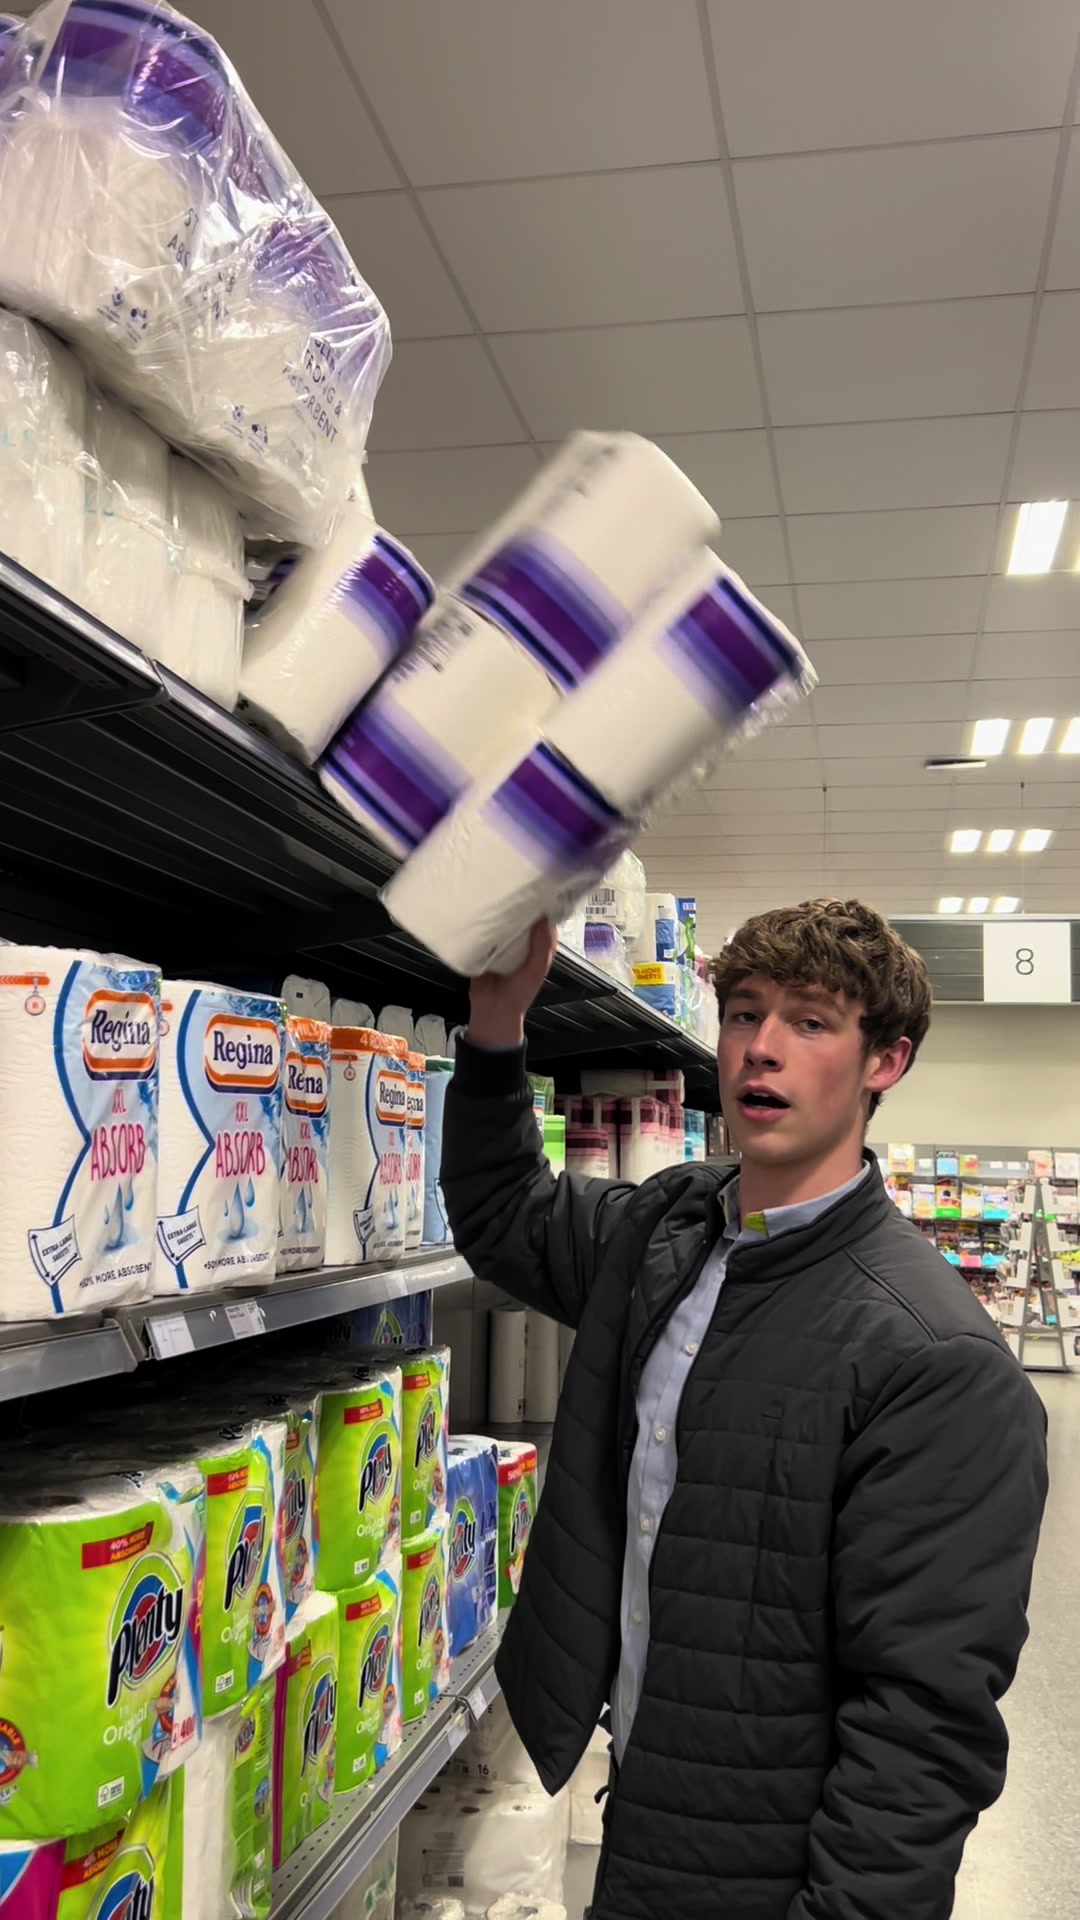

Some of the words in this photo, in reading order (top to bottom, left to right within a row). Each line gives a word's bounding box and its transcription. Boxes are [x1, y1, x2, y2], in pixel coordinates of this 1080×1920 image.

[1016, 948, 1034, 975] 8
[91, 1009, 151, 1052] Regina
[213, 1030, 273, 1070] Regina
[111, 1088, 127, 1114] XXL
[379, 1081, 405, 1110] Regina
[235, 1101, 249, 1122] XXL
[91, 1122, 146, 1182] ABSORB
[216, 1131, 265, 1179] ABSORB
[95, 1270, 117, 1285] MORE
[109, 1538, 129, 1551] 40%
[106, 1583, 184, 1708] Plenty
[478, 1764, 489, 1775] 16
